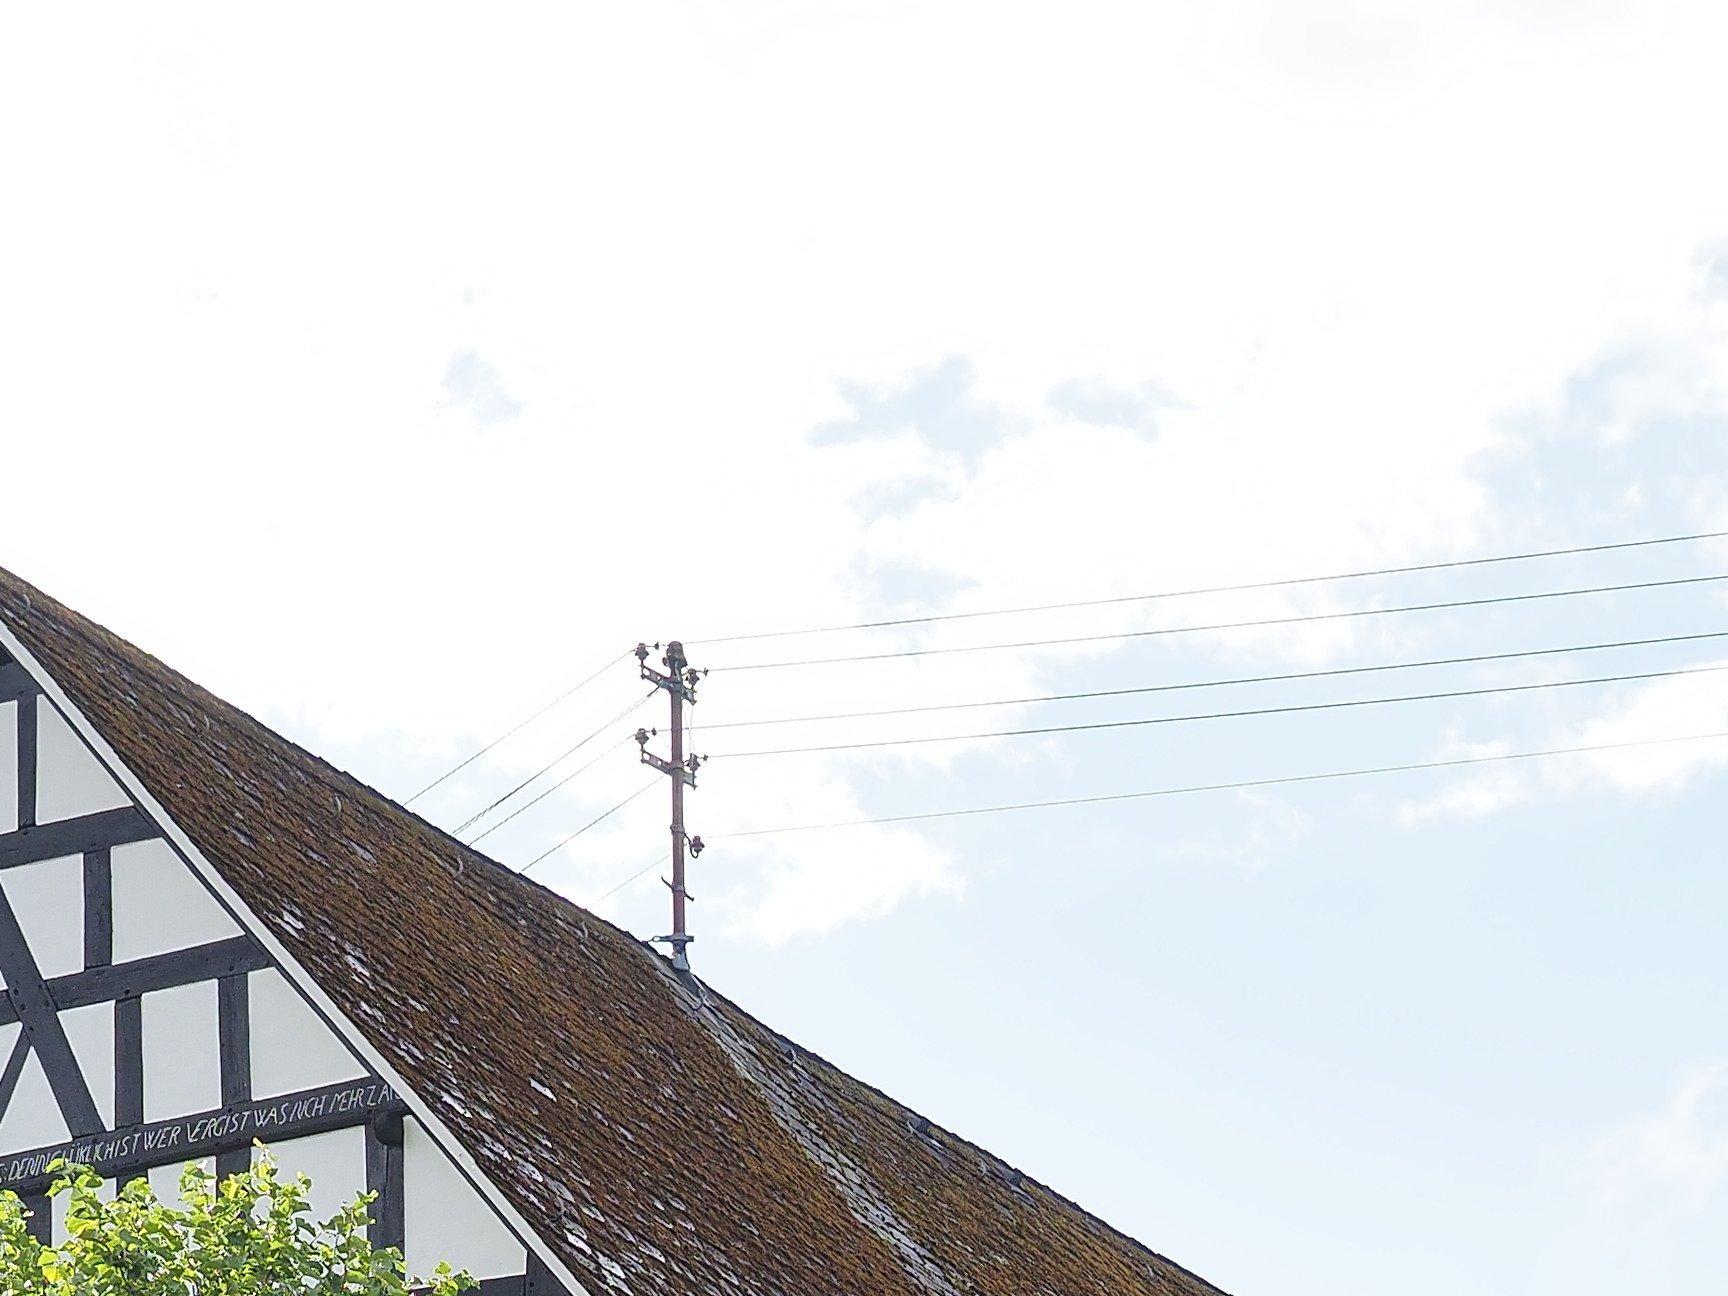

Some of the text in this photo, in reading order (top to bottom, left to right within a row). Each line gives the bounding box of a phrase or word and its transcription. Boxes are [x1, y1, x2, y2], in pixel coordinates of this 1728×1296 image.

[143, 1125, 182, 1150] WER
[186, 1110, 251, 1142] VERGIST
[253, 1103, 287, 1128] WAS
[329, 1087, 364, 1113] MEHR
